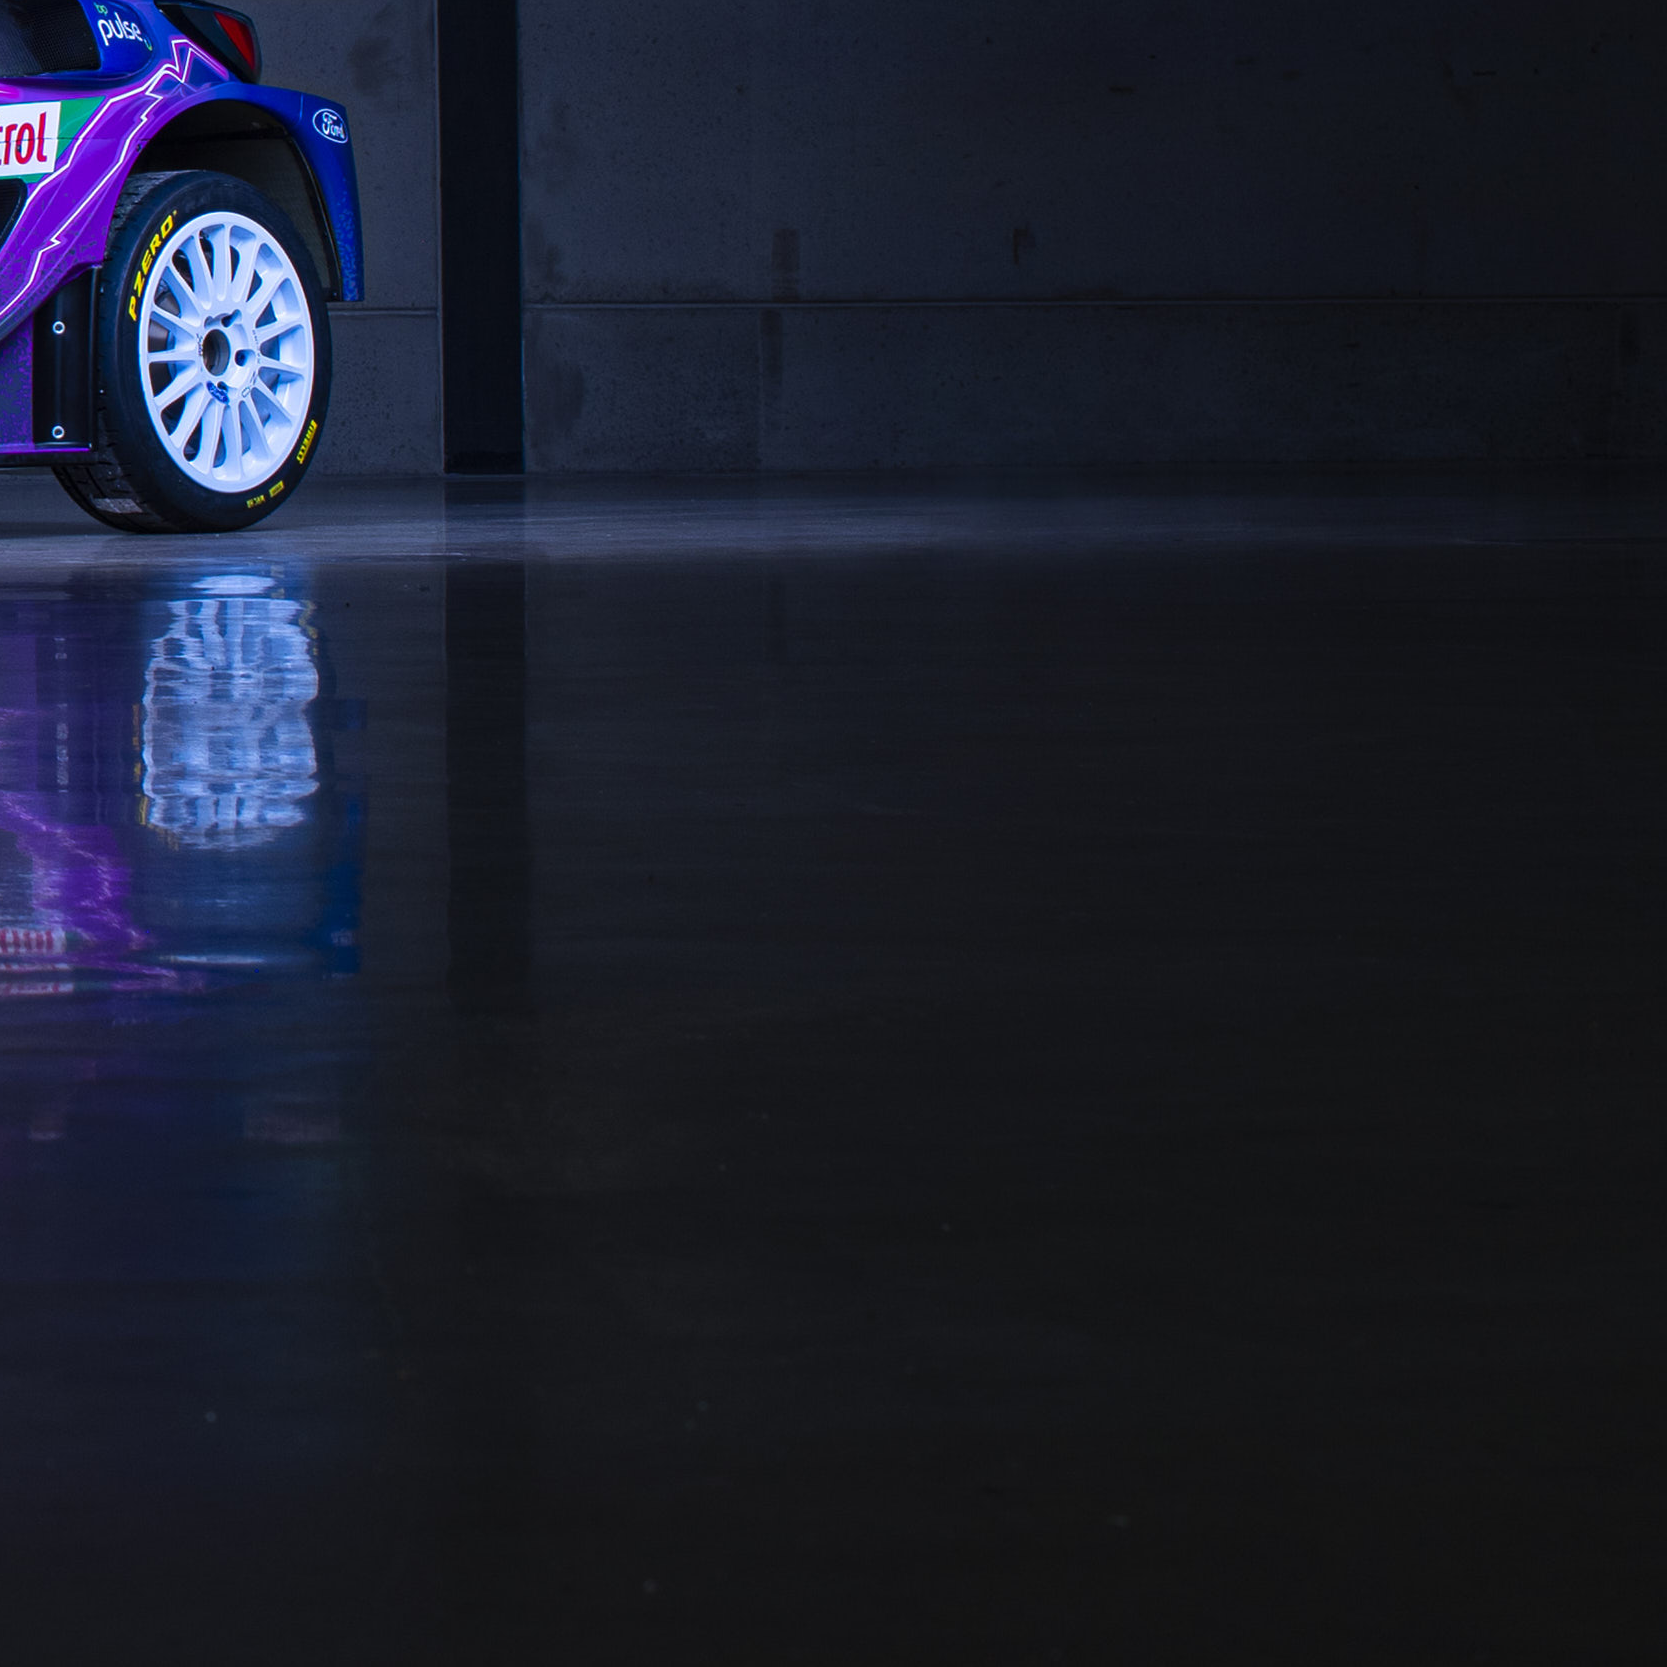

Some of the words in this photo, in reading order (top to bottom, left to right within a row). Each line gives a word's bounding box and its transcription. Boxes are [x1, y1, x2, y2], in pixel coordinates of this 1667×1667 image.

[94, 2, 109, 16] bp
[97, 13, 142, 47] pulse
[321, 111, 346, 139] Ford
